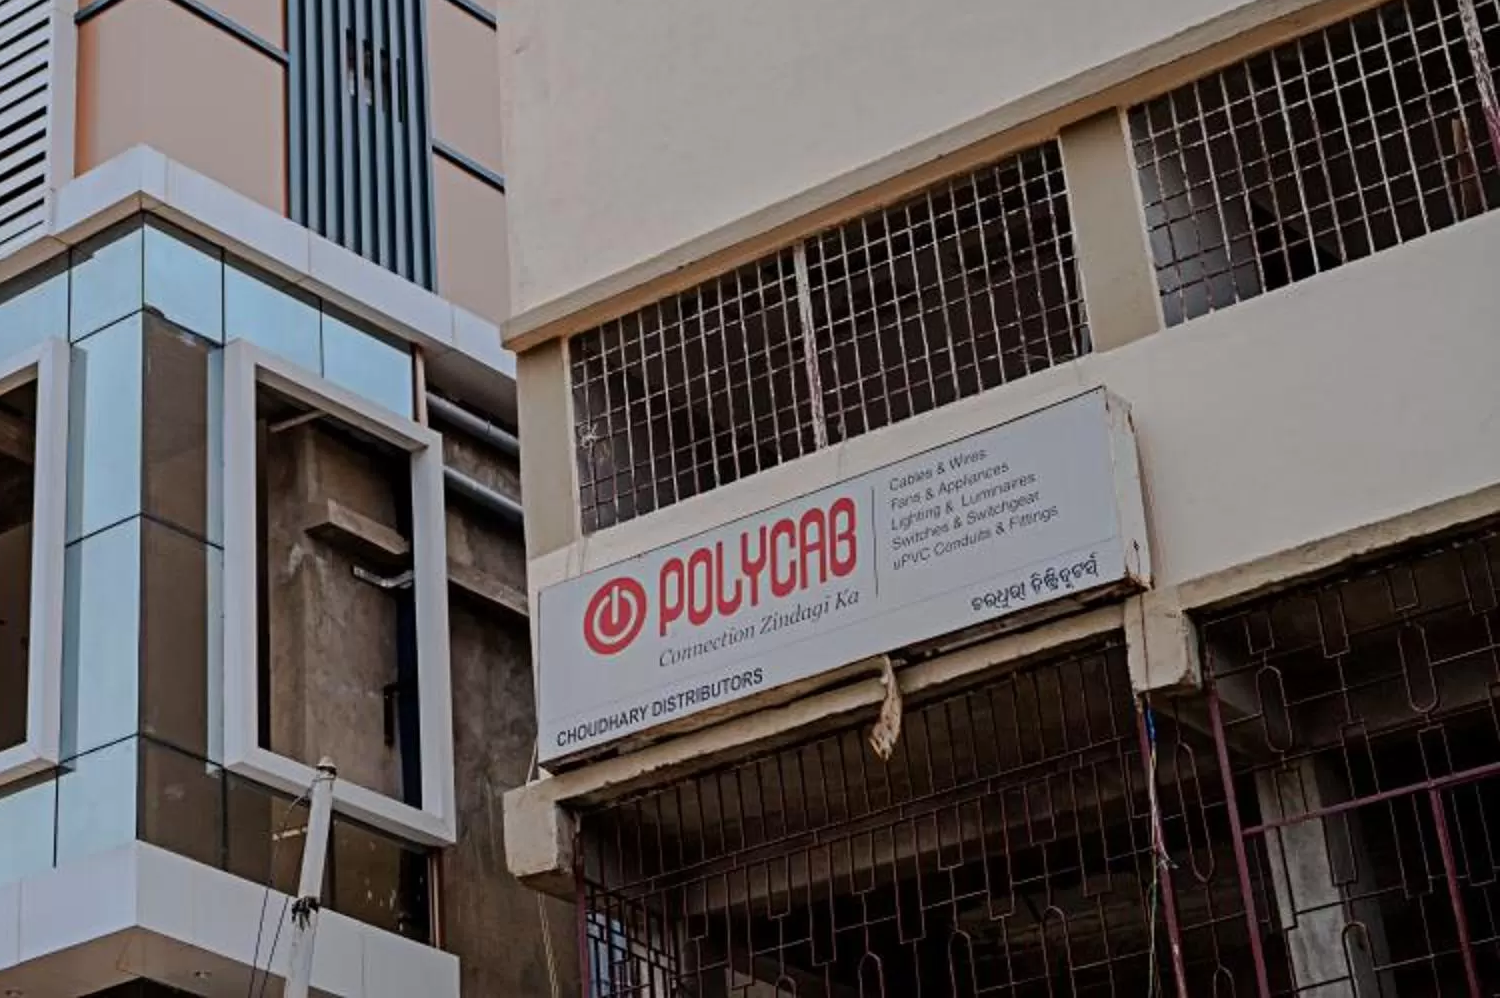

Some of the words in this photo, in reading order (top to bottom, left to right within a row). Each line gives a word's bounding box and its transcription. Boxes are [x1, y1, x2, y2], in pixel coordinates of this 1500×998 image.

[889, 469, 933, 491] Cables
[936, 462, 946, 475] &
[949, 449, 987, 470] Wires
[890, 491, 922, 511] Fans
[925, 487, 935, 501] &
[938, 461, 1010, 496] Appliances
[891, 506, 941, 532] Lighting
[945, 500, 953, 514] &
[960, 472, 1037, 507] Luminaires
[892, 522, 949, 550] Switches
[953, 514, 963, 529] &
[966, 490, 1040, 525] Switchgear
[659, 497, 858, 637] POLYCAB
[893, 547, 931, 570] uPVC
[933, 528, 993, 556] Conduits
[995, 521, 1005, 535] &
[1008, 505, 1059, 530] Fittings
[658, 623, 756, 667] Connection
[758, 597, 830, 635] Zindagi
[835, 587, 860, 610] Ka
[556, 703, 650, 747] CHOUDHARY
[651, 667, 764, 717] DISTRIBUTORS
